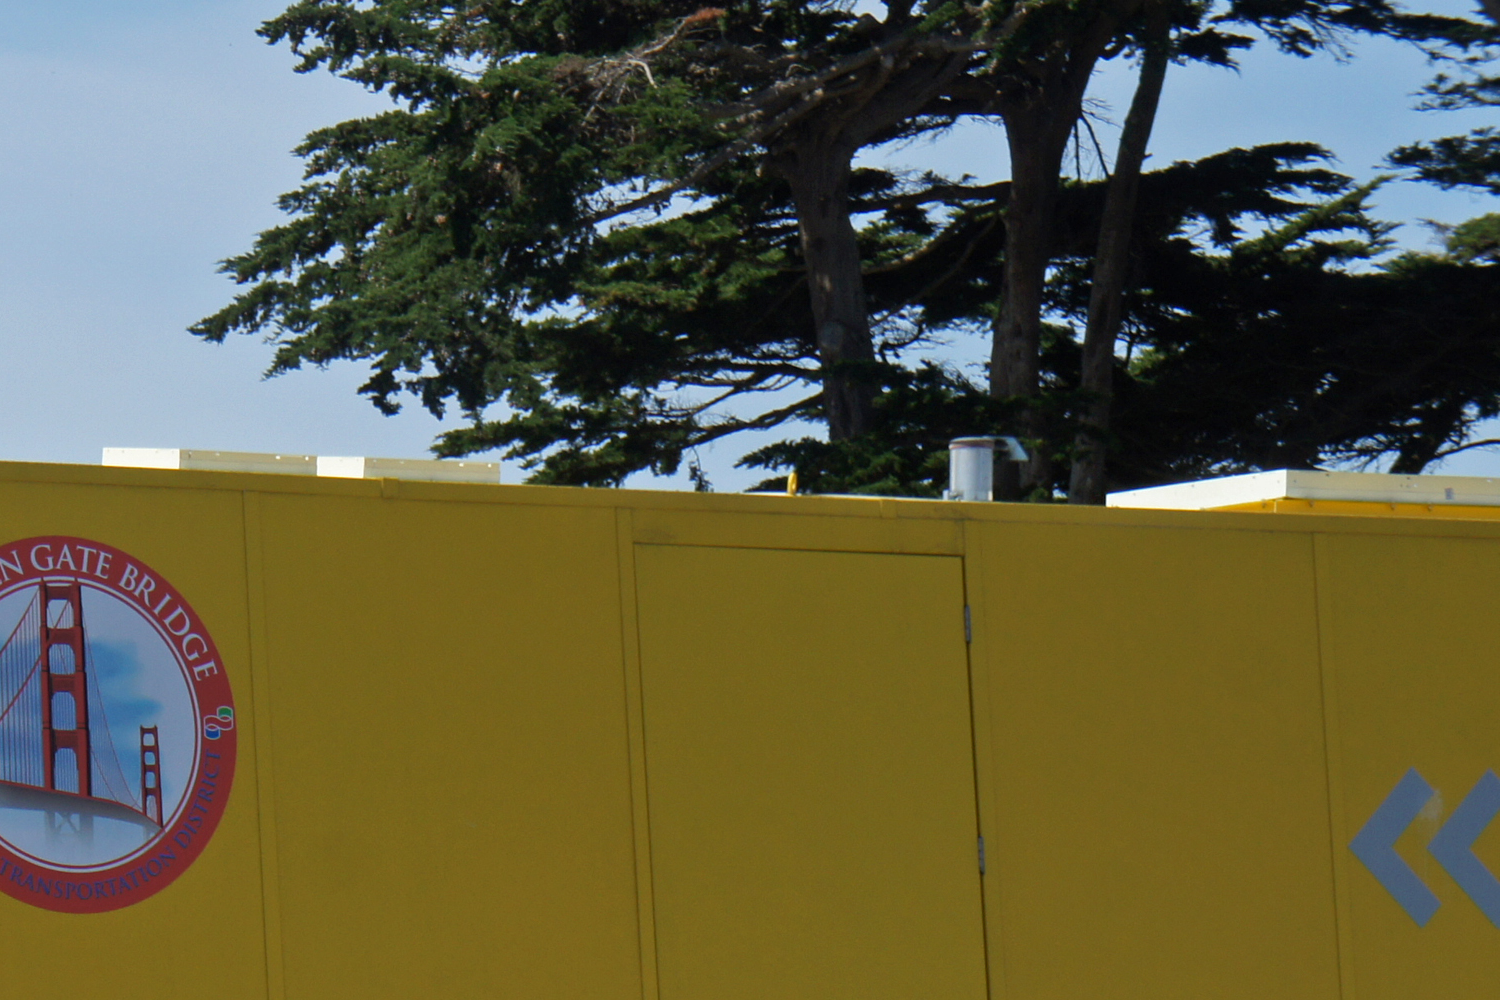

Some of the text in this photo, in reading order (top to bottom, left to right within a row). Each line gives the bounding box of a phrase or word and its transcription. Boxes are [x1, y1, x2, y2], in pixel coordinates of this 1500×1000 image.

[30, 544, 113, 579] GATE
[119, 562, 218, 681] BRIDGE
[0, 847, 177, 900] TRANSPORTATION
[173, 748, 222, 849] DISTRICT
